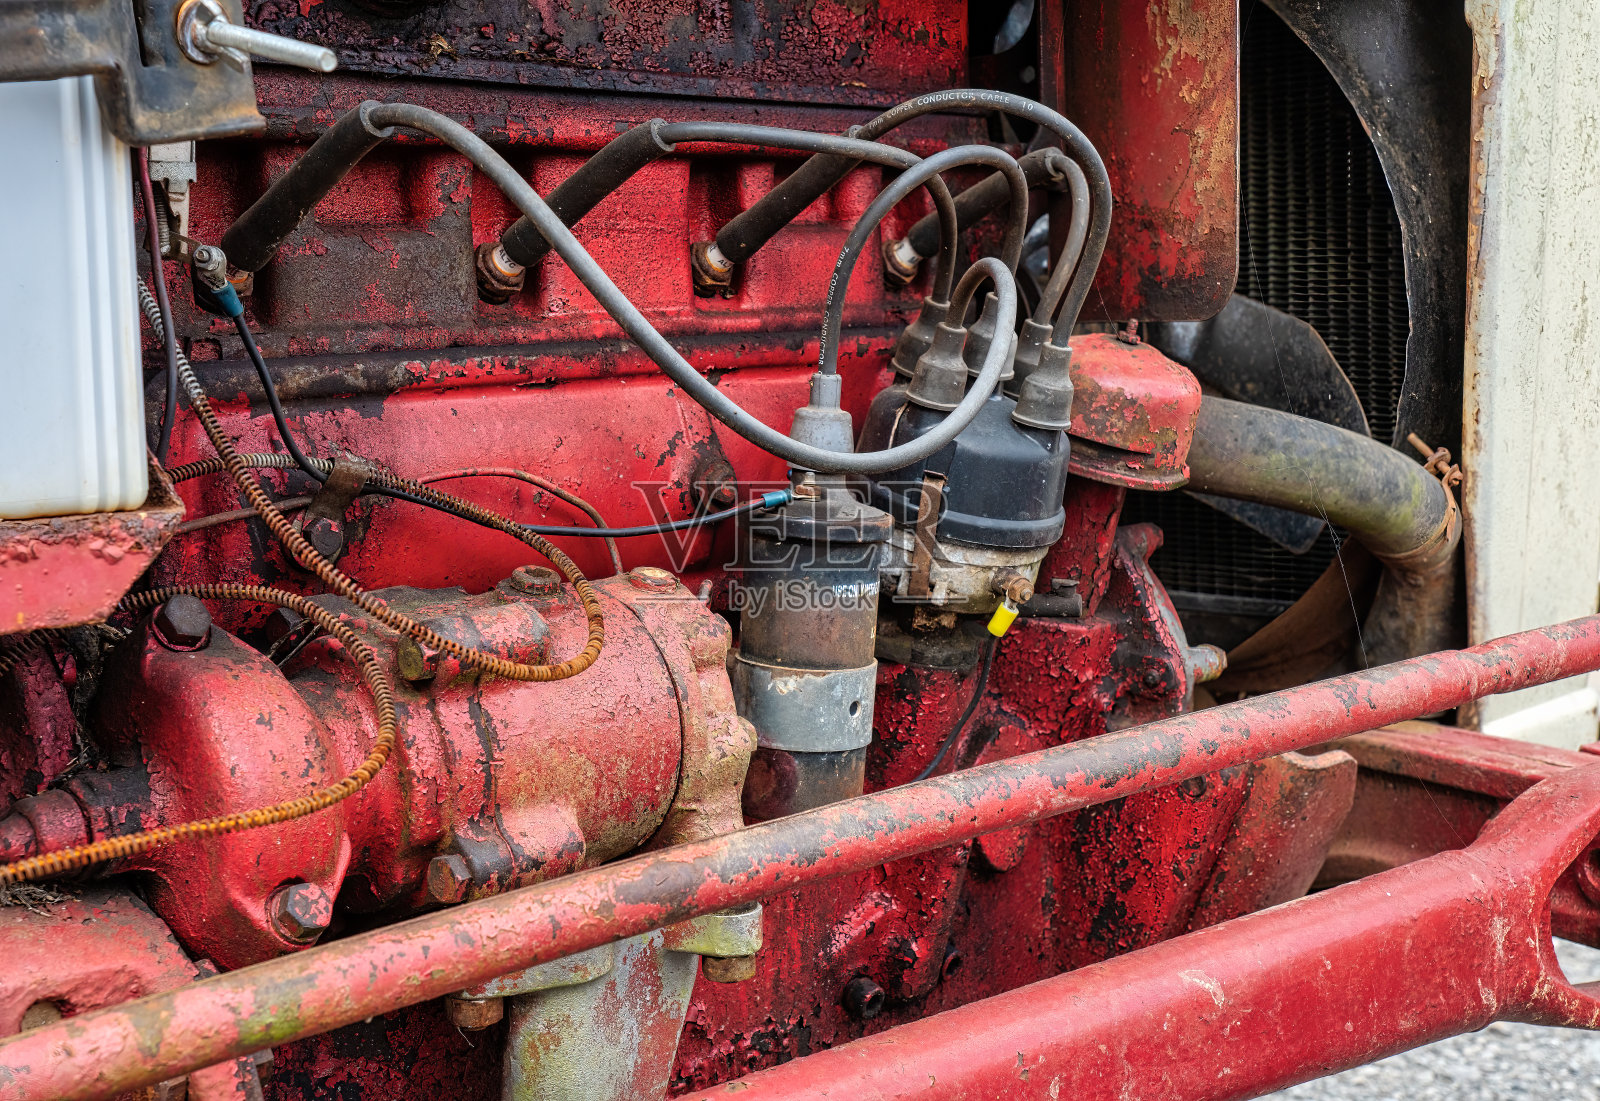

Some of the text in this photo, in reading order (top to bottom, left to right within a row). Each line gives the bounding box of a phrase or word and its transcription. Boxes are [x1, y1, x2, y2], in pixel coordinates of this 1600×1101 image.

[917, 91, 974, 106] CONDUCTOR
[980, 92, 1010, 104] CABLE
[836, 246, 850, 268] 7mm
[827, 272, 839, 305] COPPER
[818, 310, 830, 365] CONDUCTOR
